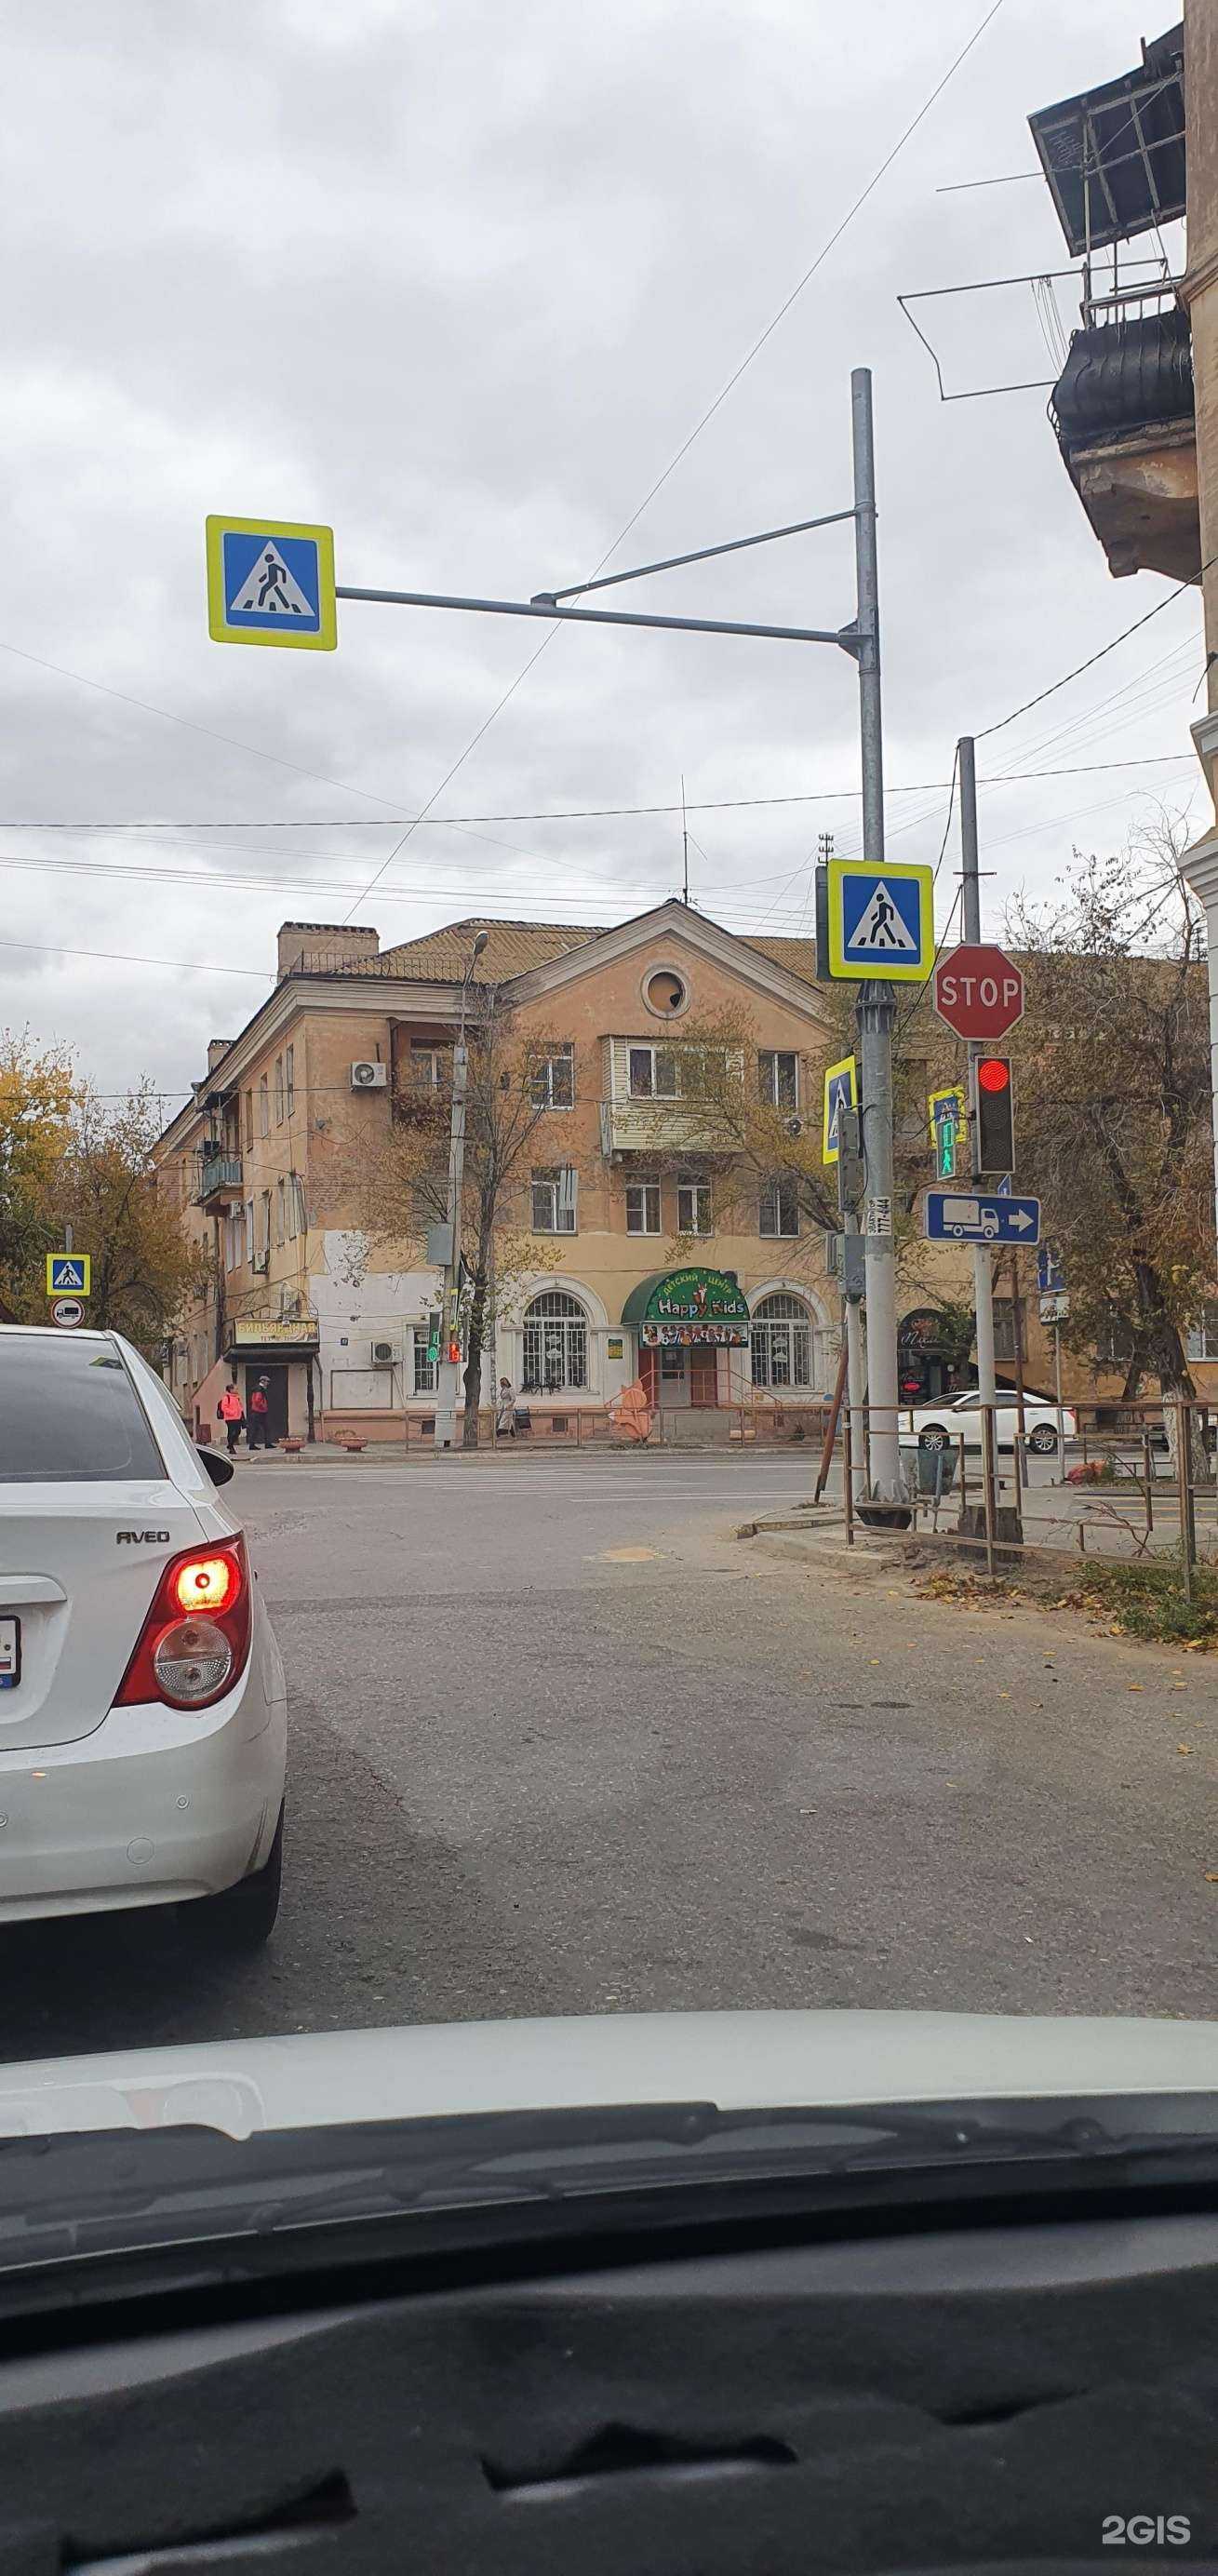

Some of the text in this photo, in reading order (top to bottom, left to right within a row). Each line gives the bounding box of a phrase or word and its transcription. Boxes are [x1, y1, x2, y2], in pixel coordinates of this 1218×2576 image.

[941, 976, 1019, 1007] STOP
[663, 1274, 731, 1295] ДЕТСКИЙ ЦЕНТР
[658, 1298, 707, 1318] Happy
[116, 1531, 169, 1544] AVEO
